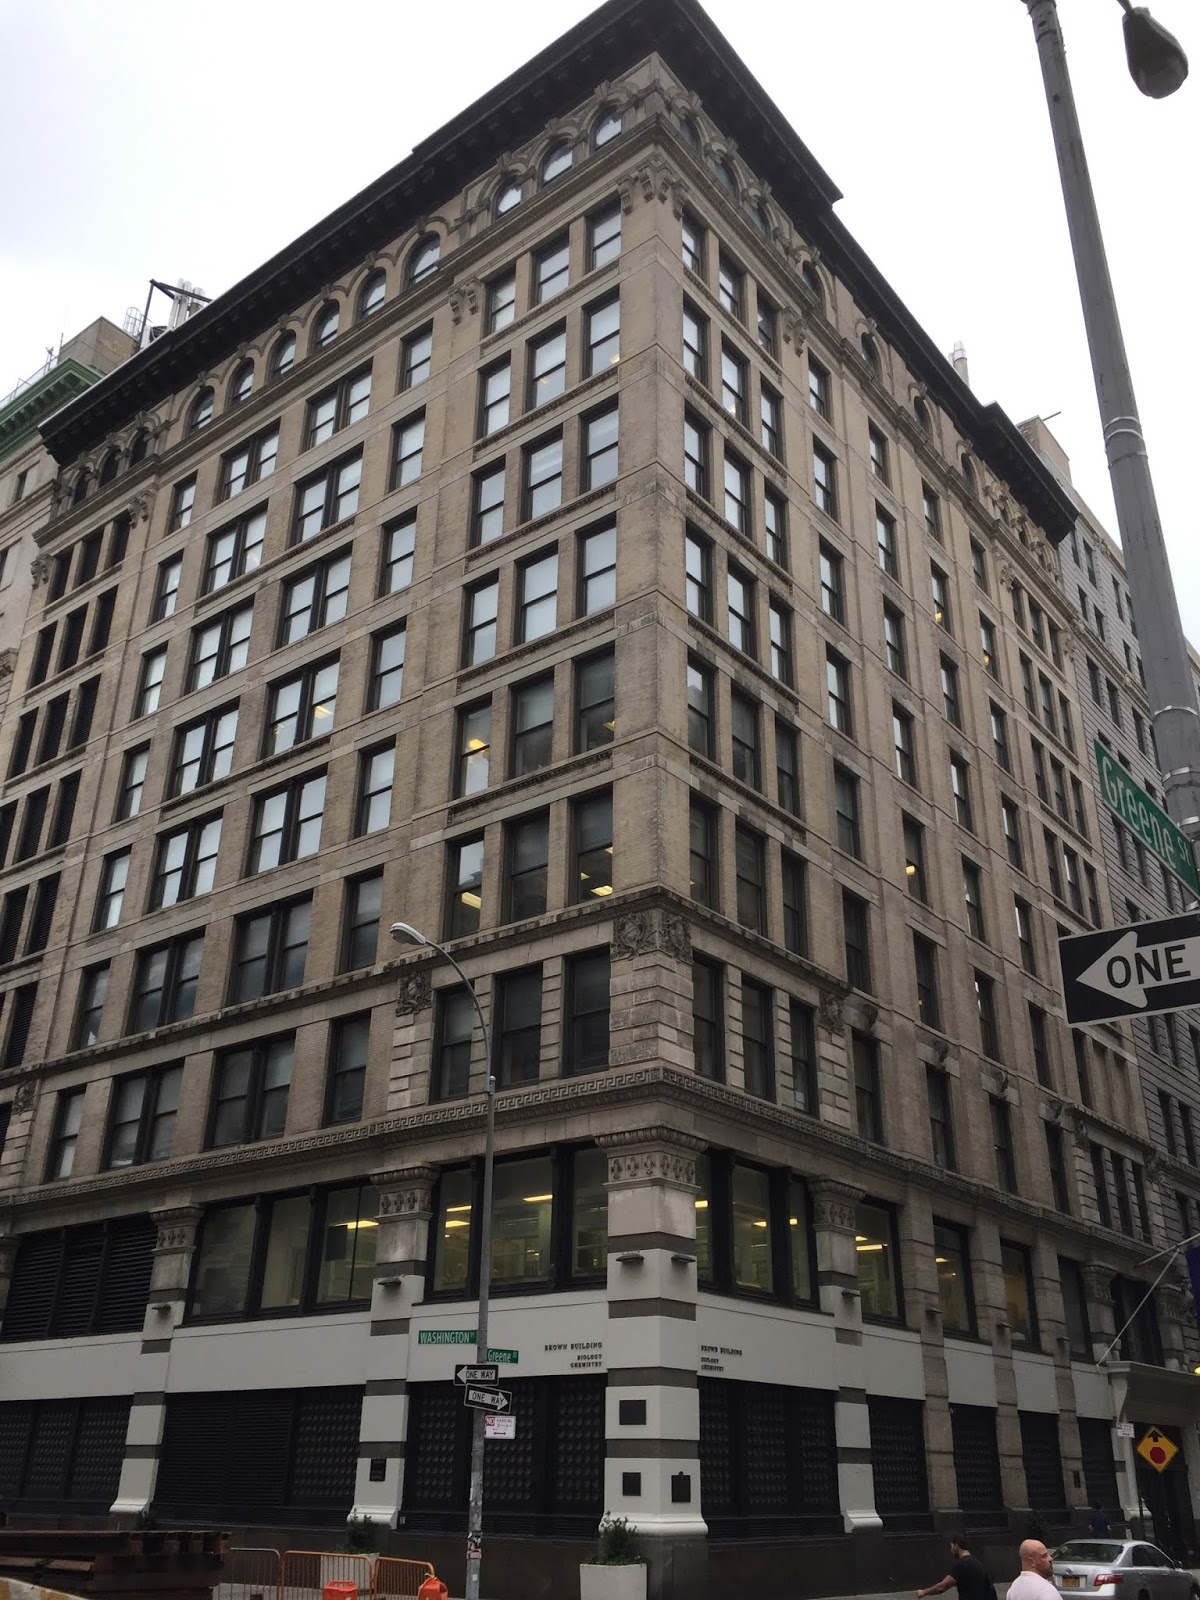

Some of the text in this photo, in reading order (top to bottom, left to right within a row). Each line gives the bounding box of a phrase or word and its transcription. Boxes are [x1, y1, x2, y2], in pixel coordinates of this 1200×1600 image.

[1102, 754, 1177, 870] Greene
[1106, 943, 1191, 989] ONE
[420, 1331, 470, 1344] WASHINGTON
[570, 1342, 602, 1350] BUILDING
[487, 1349, 511, 1362] Greene
[465, 1371, 494, 1379] ONE WAY
[472, 1391, 505, 1406] ONE WAY
[486, 1417, 495, 1426] NO
